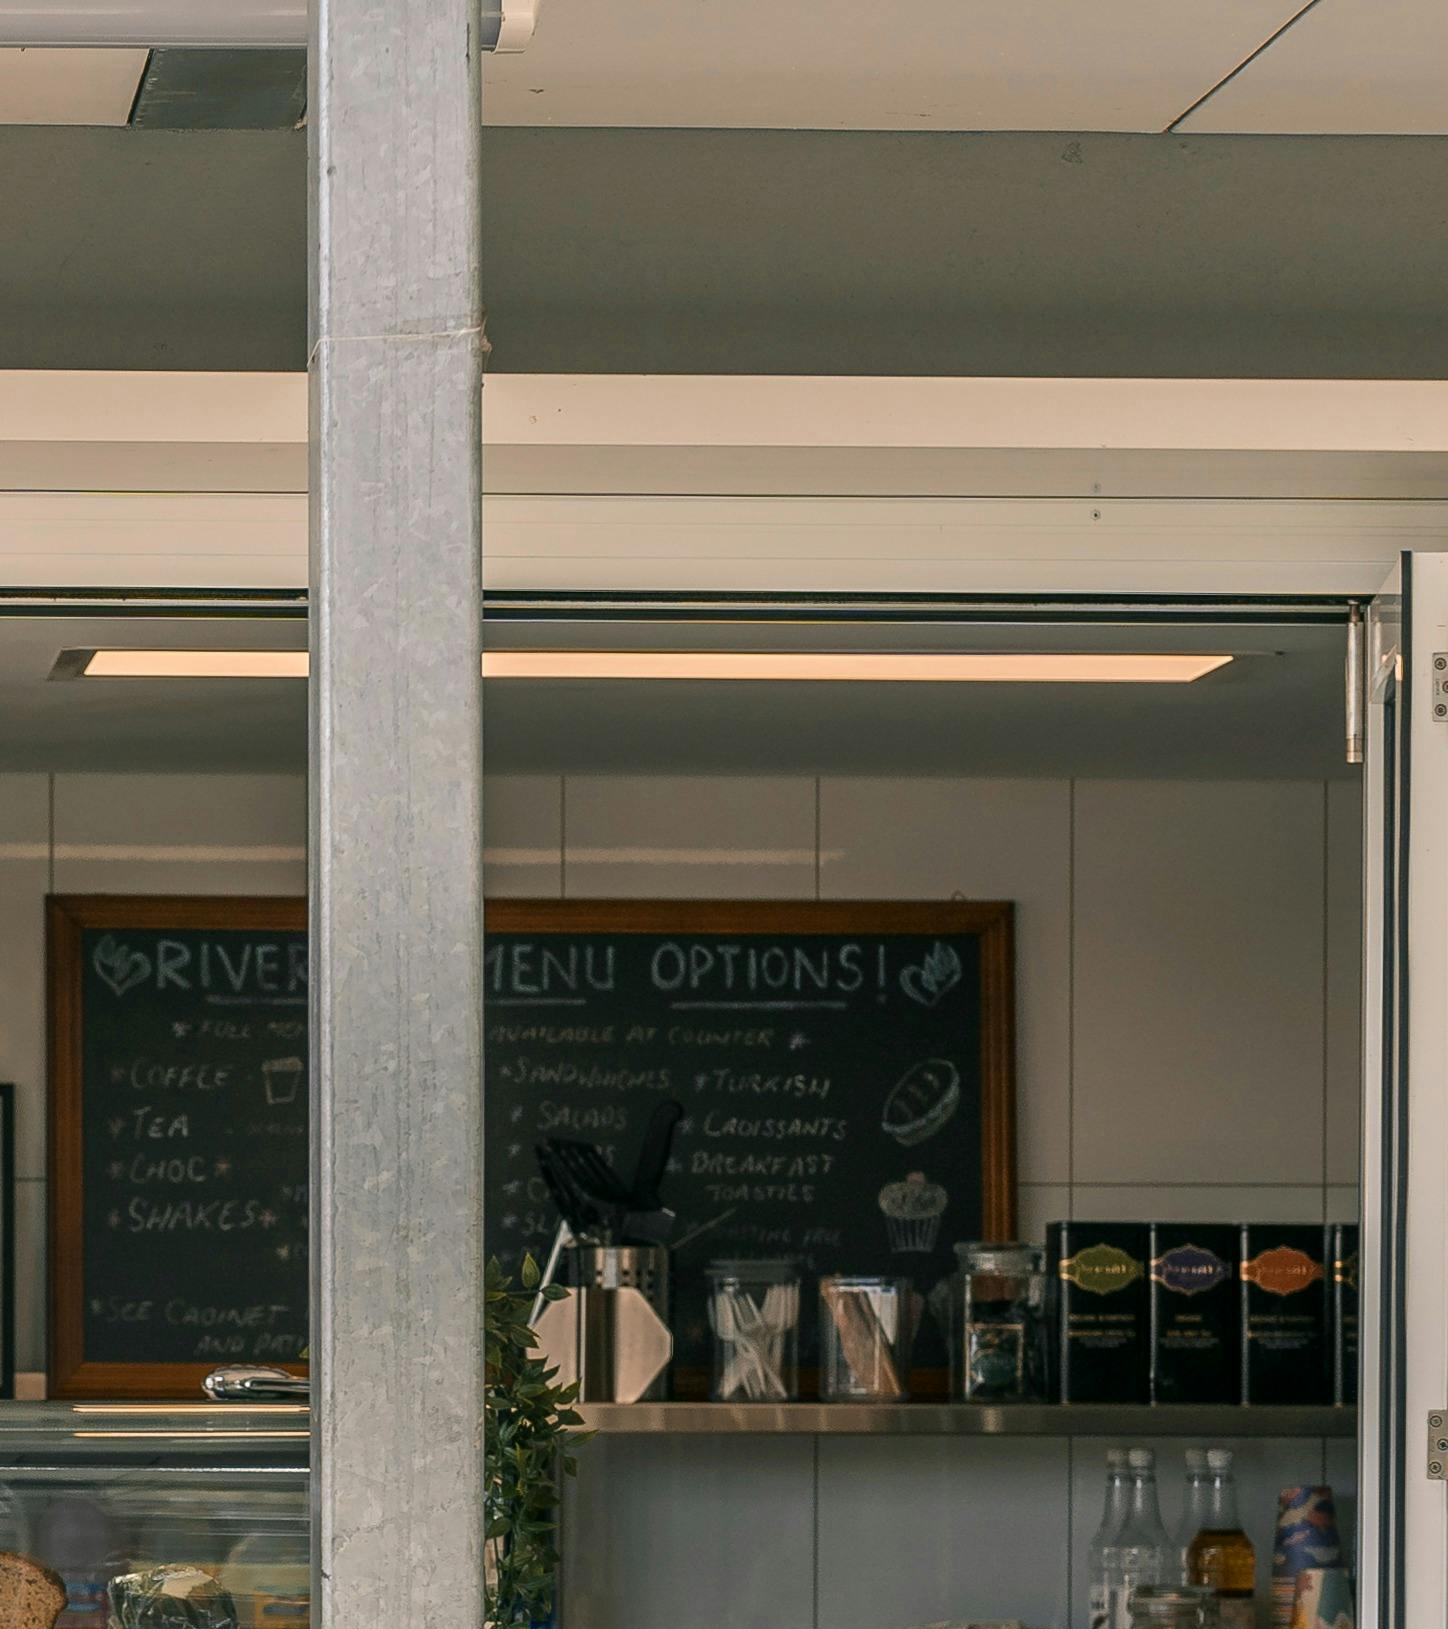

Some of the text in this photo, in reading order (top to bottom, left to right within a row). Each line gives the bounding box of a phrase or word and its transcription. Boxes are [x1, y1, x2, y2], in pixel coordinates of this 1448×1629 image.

[650, 942, 885, 1004] OPTIONS!
[132, 1105, 189, 1139] TEA
[690, 1151, 834, 1176] BREAKFAST
[128, 1196, 260, 1233] SHAKES
